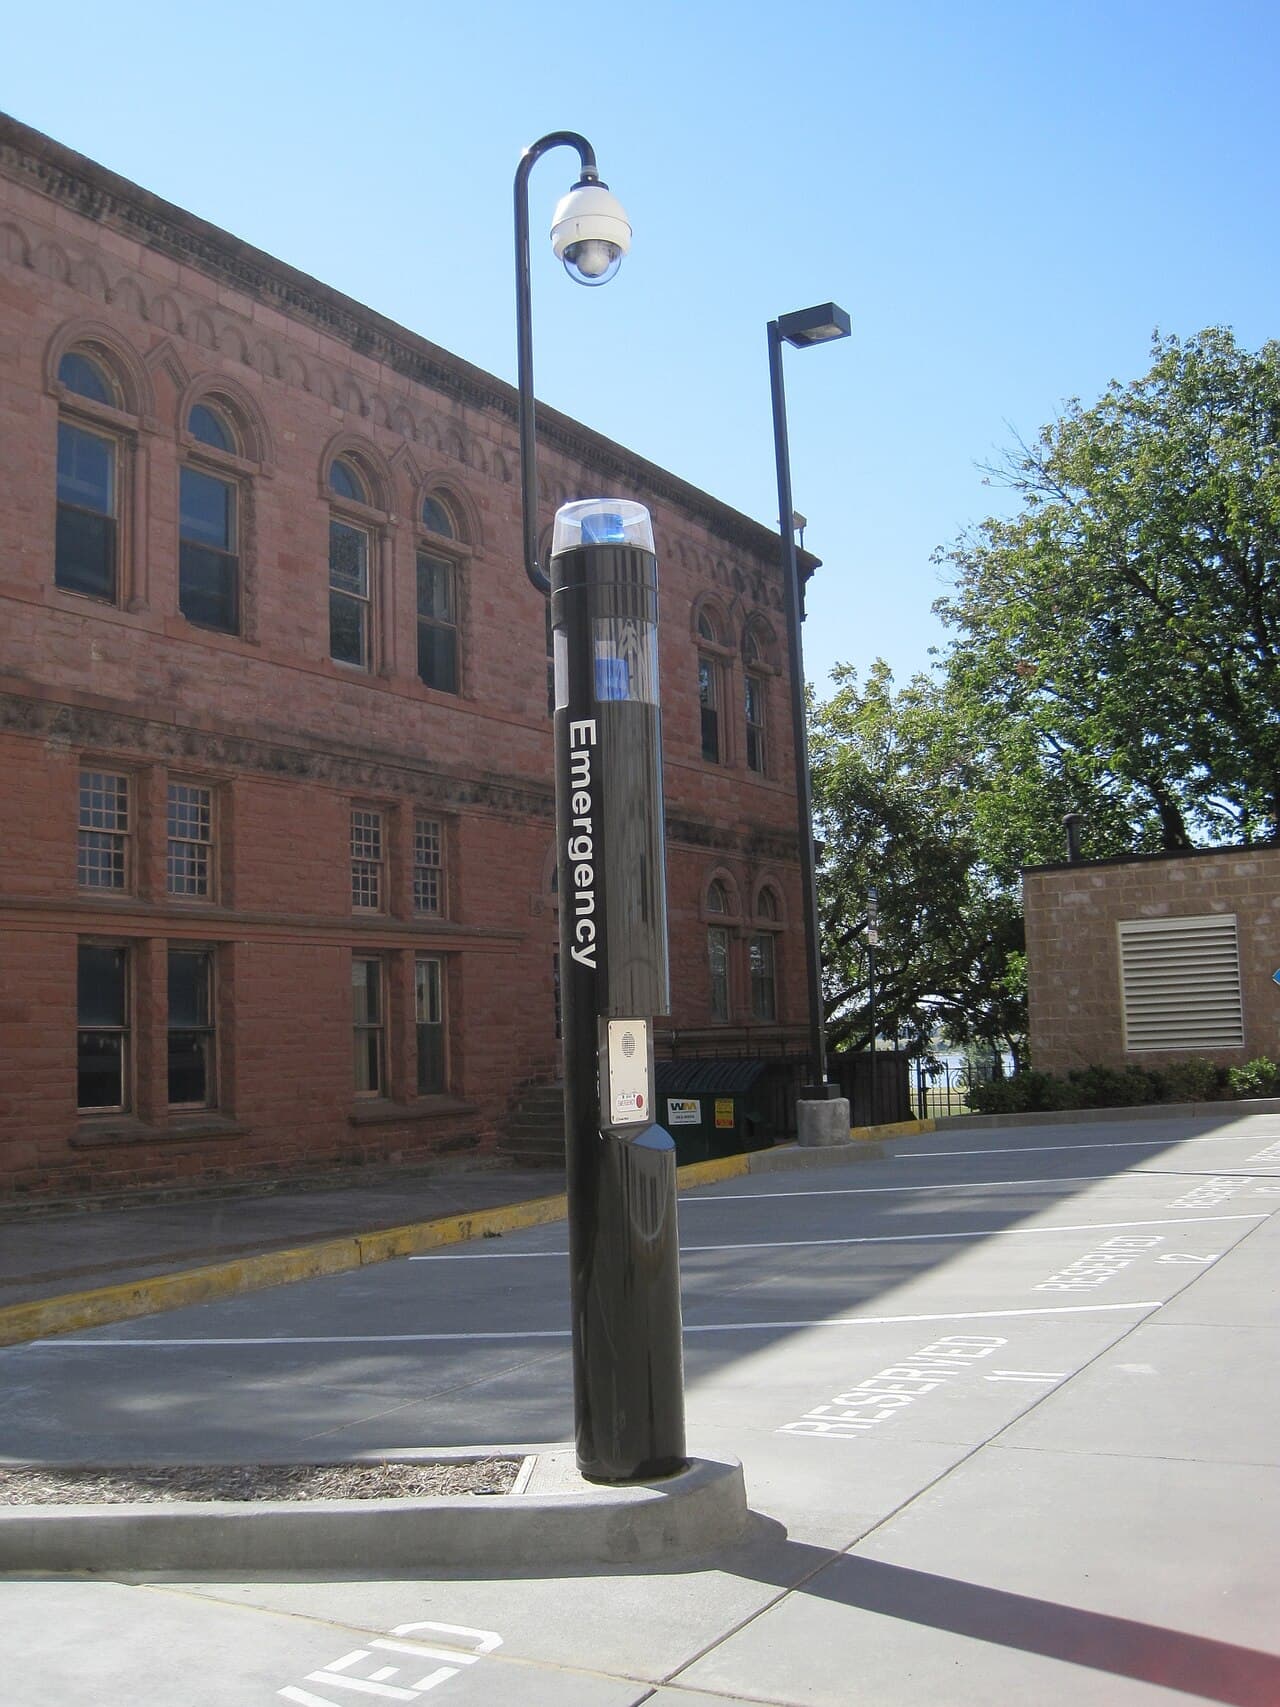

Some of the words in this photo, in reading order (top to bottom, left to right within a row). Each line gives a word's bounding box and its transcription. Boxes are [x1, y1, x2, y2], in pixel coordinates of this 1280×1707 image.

[568, 718, 598, 969] Emergency
[669, 1102, 698, 1111] WM
[1031, 1235, 1165, 1292] RESERVED
[1153, 1252, 1221, 1264] 12
[775, 1335, 1009, 1439] RESERVED
[983, 1370, 1067, 1383] 11
